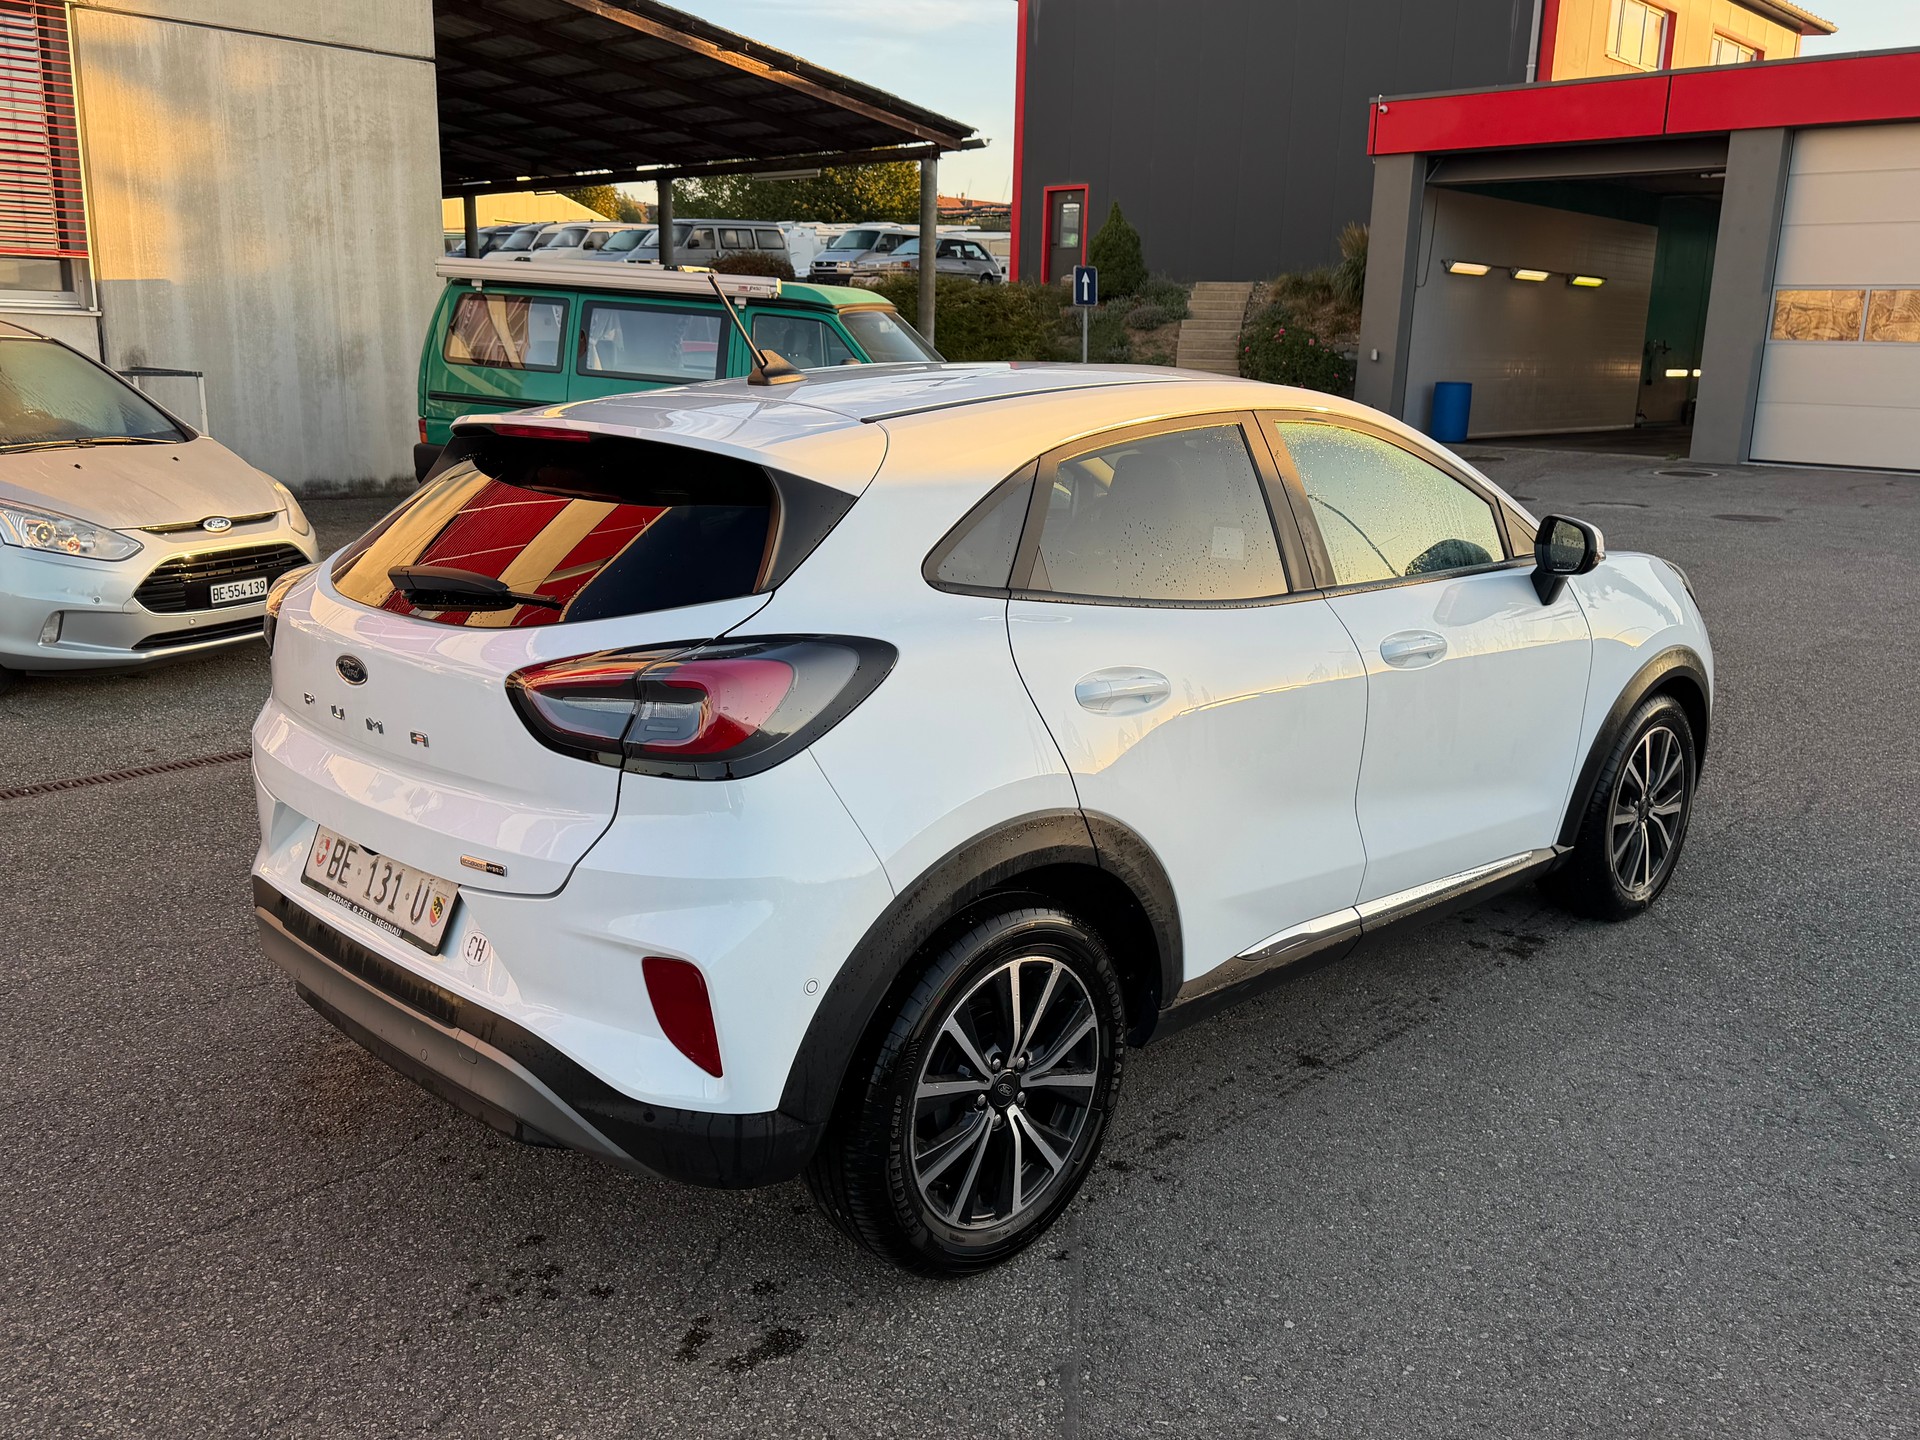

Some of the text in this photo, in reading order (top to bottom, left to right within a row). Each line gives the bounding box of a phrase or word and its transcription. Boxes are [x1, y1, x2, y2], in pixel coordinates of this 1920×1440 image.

[248, 580, 266, 595] 139
[303, 691, 430, 748] PUMA
[326, 891, 353, 910] GARAGE
[375, 915, 402, 937] HEGNAU
[467, 935, 487, 962] CH
